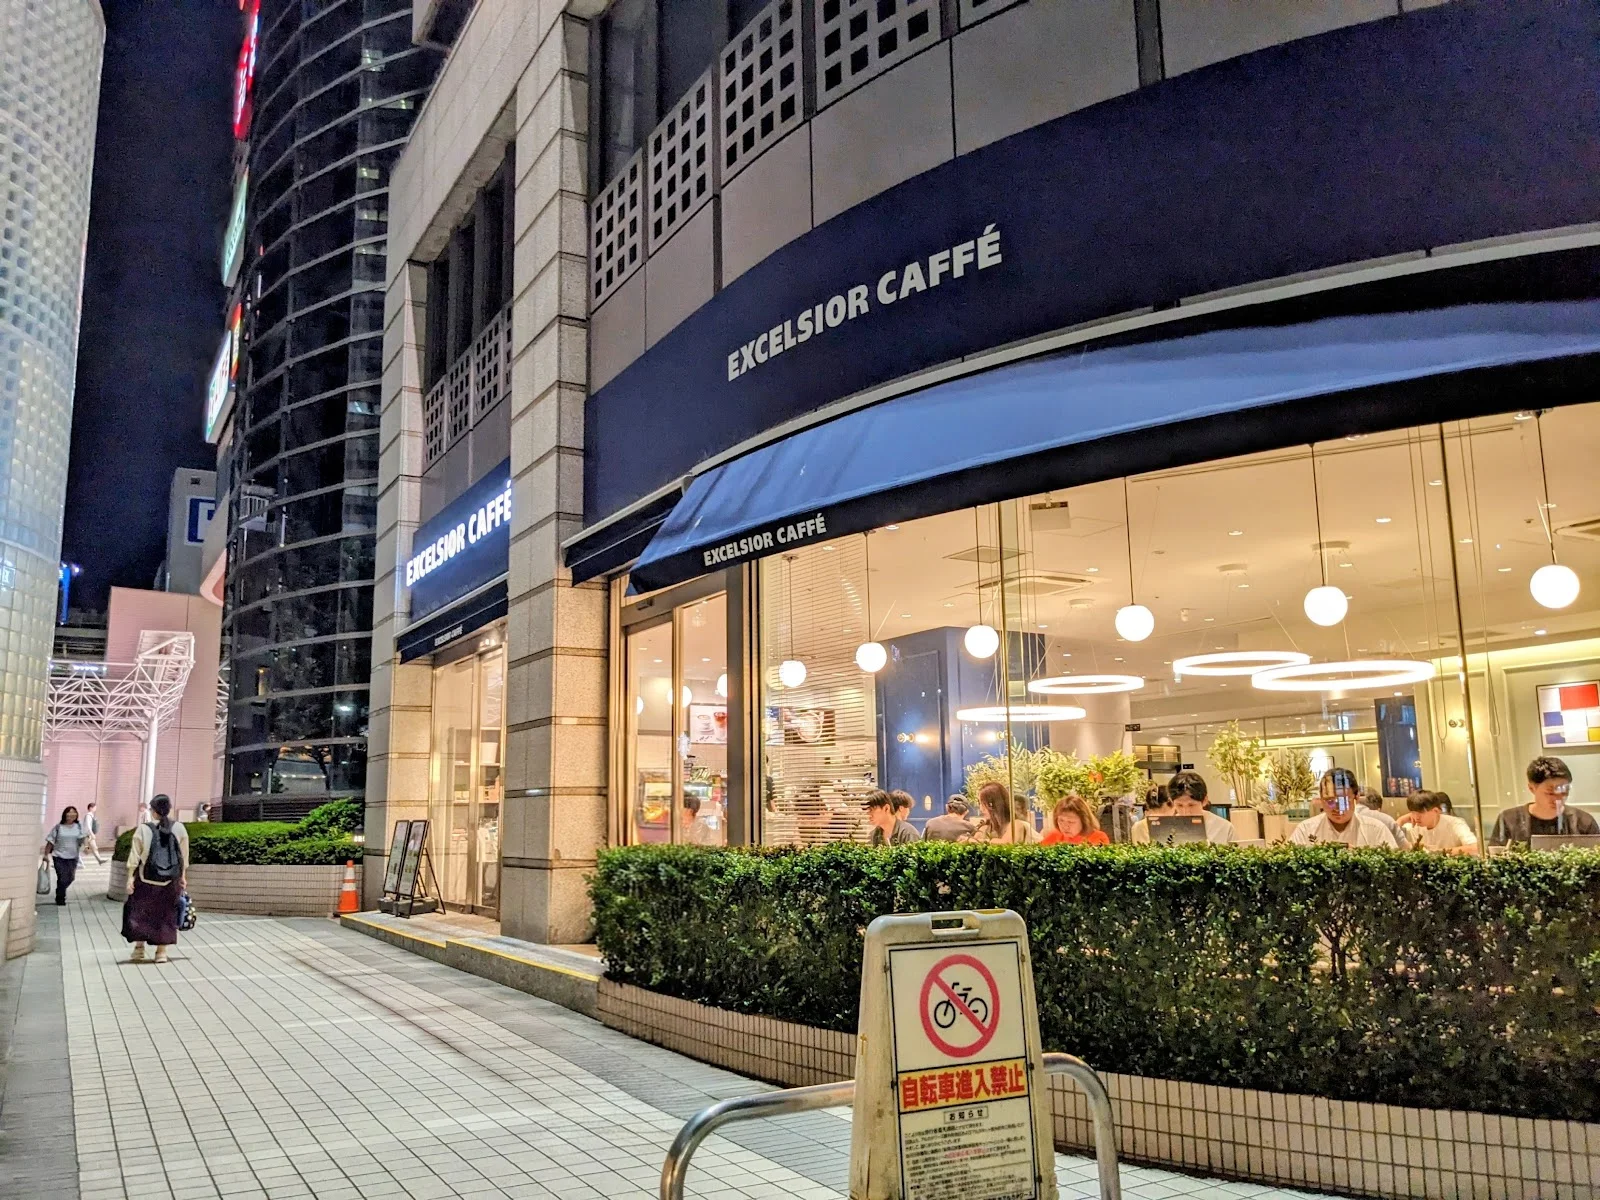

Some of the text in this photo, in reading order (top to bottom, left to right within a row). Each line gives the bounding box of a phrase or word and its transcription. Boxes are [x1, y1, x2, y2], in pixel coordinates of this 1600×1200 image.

[727, 223, 1002, 382] EXCELSIOR CAFFÉ
[406, 480, 512, 587] EXCELSIOR CAFFÉ
[703, 513, 827, 567] EXCELSIOR CAFFÉ
[902, 1063, 1025, 1109] 自転車進入禁止
[949, 1109, 983, 1121] お知らせ
